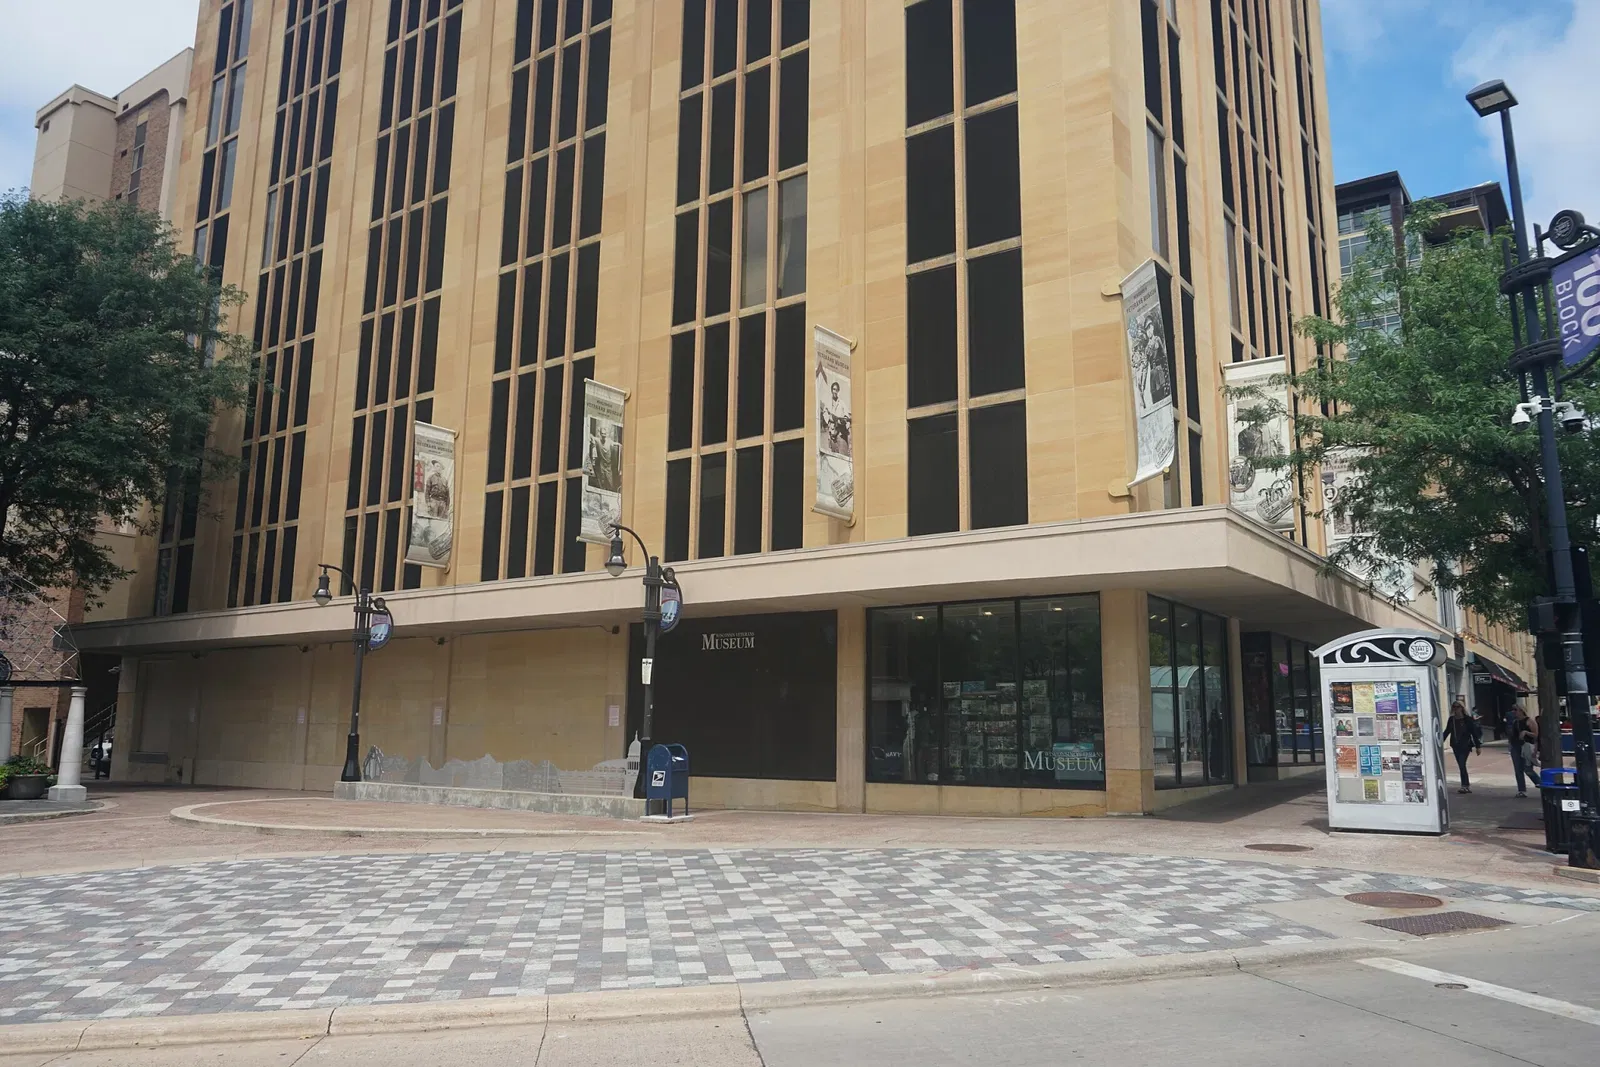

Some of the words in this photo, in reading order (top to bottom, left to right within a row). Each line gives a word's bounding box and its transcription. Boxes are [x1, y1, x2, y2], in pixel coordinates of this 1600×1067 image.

[1555, 279, 1581, 349] BLOCK
[1573, 253, 1600, 336] 100
[701, 633, 755, 650] MUSEUM
[1023, 750, 1103, 771] MUSEUM
